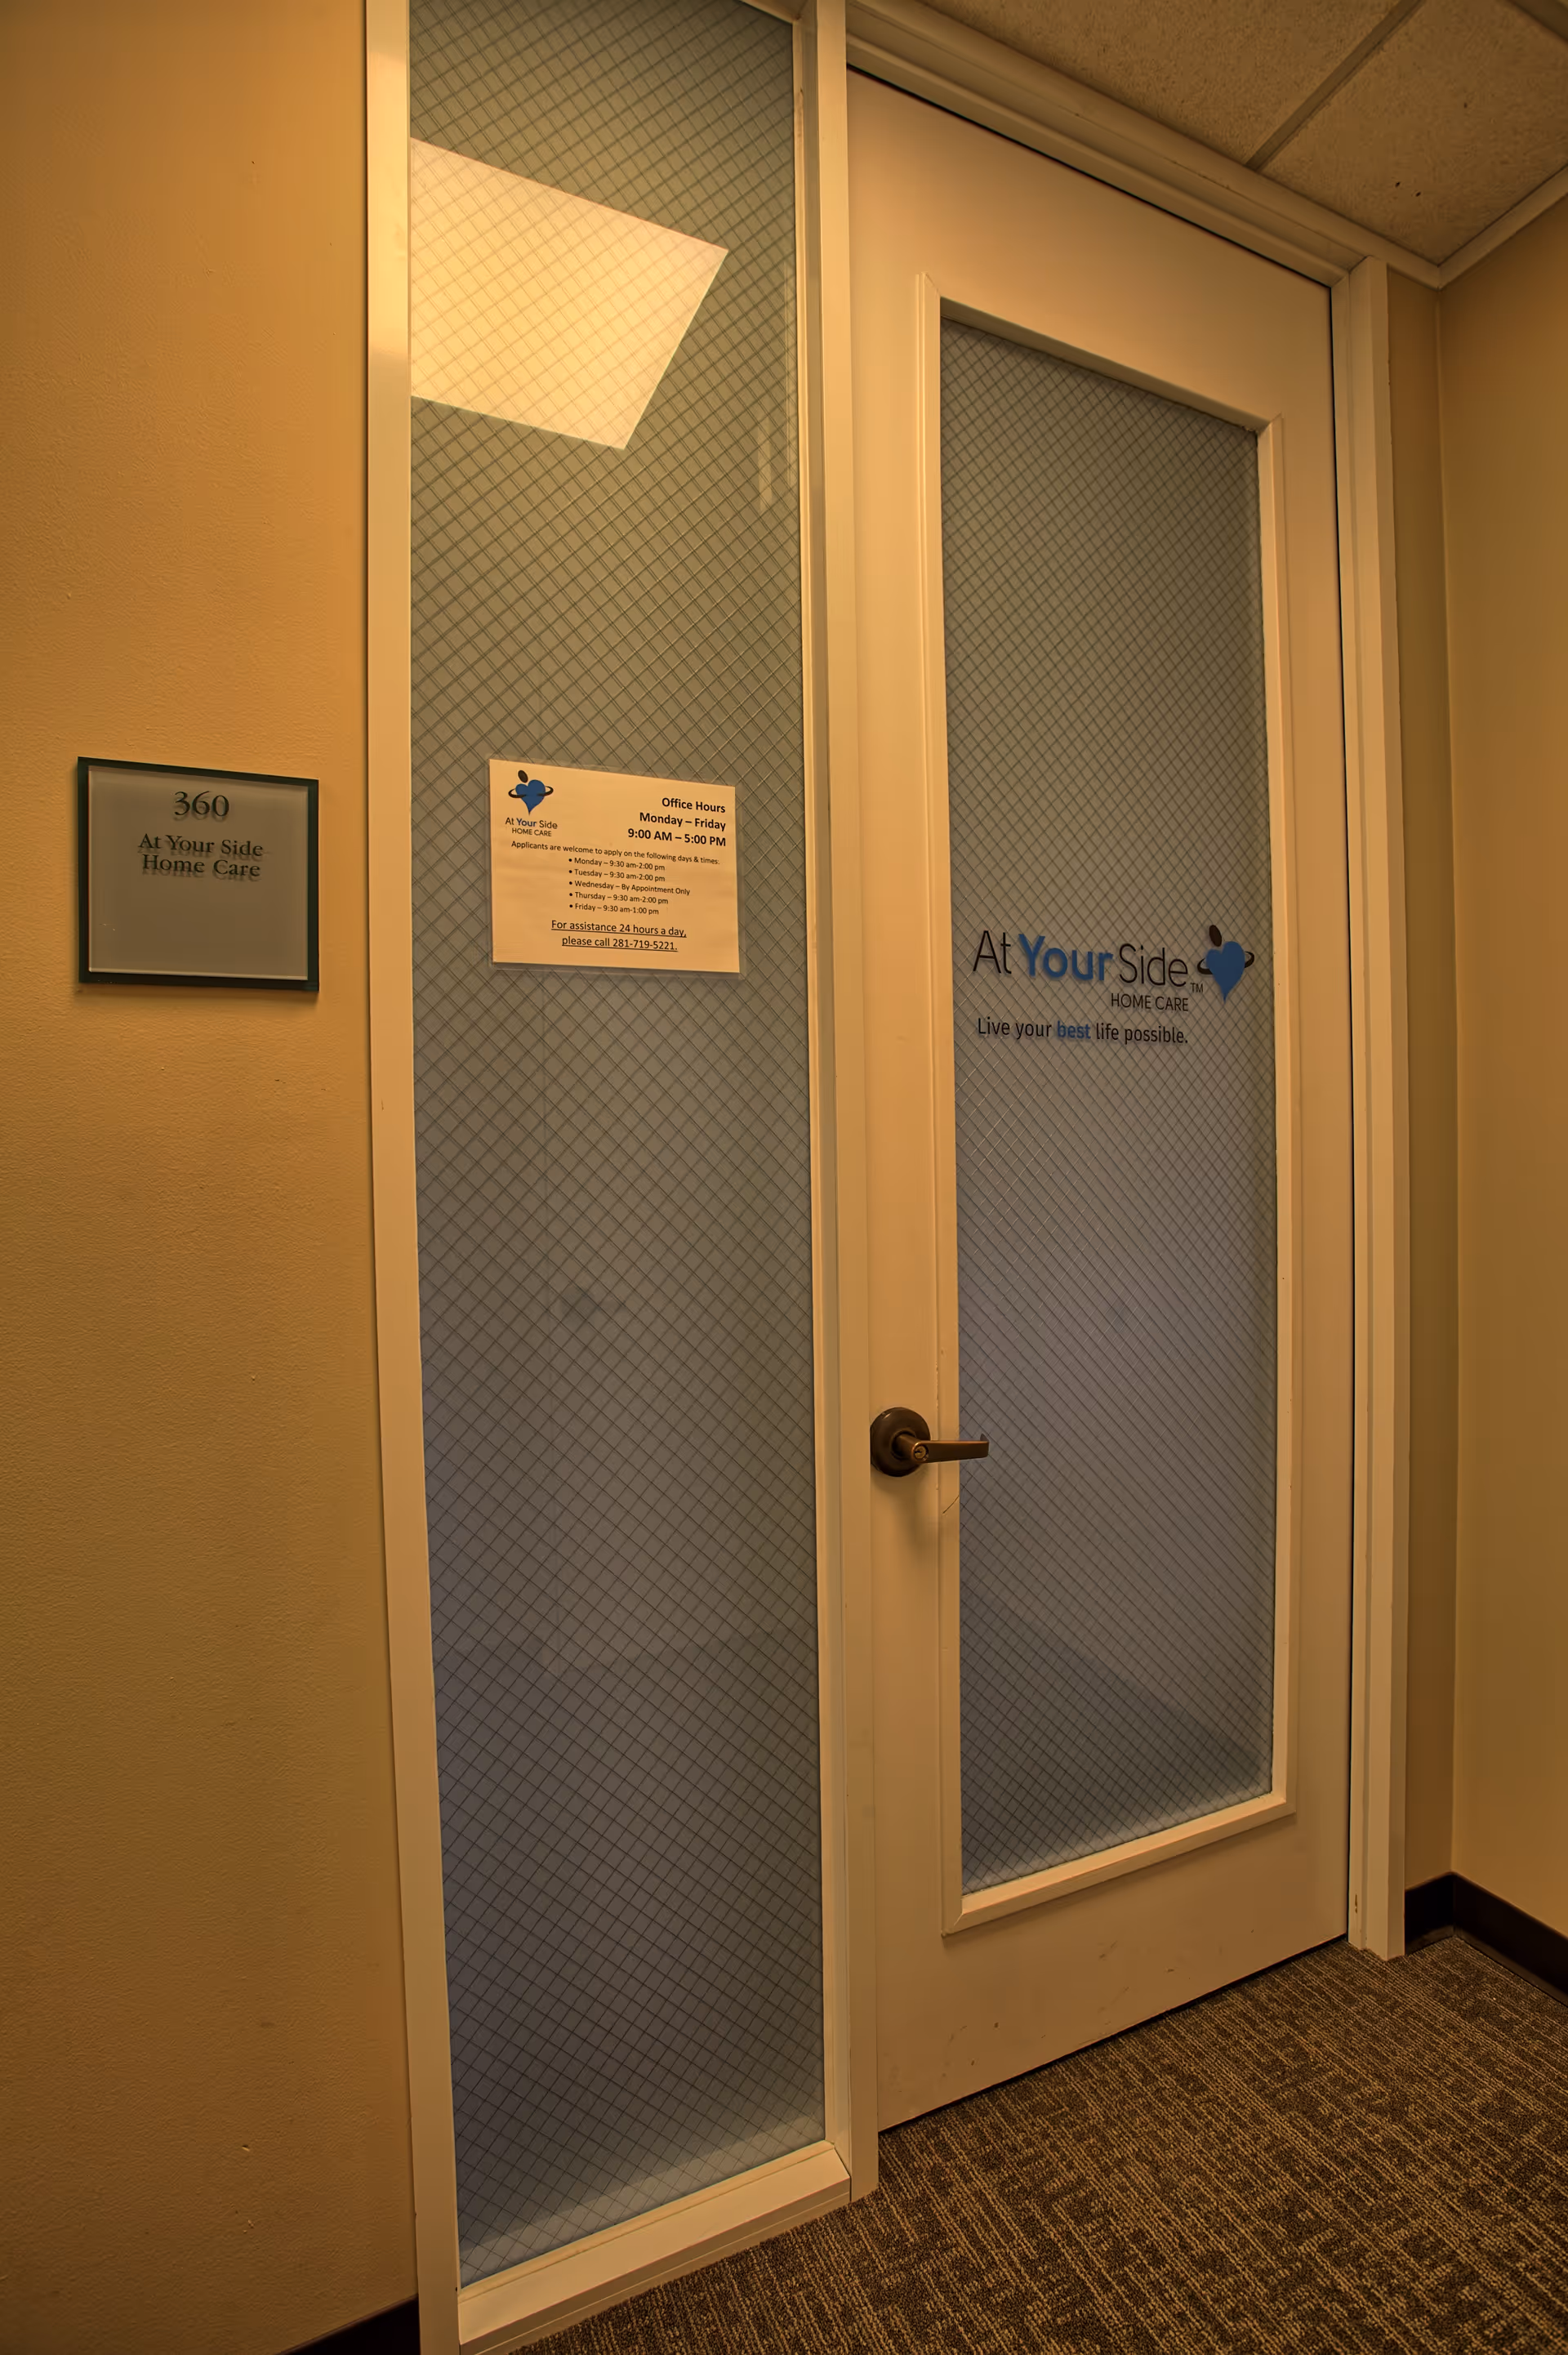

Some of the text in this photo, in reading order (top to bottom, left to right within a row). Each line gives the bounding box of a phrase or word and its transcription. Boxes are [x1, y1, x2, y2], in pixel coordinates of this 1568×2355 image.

[174, 791, 229, 817] 360
[662, 797, 726, 813] Office Hours
[506, 817, 558, 829] At Your Side
[639, 812, 683, 827] Monday
[695, 818, 726, 832] Friday
[138, 833, 263, 856] At Your Side
[628, 828, 651, 839] 9:00
[654, 831, 672, 841] AM
[684, 834, 706, 845] 5:00
[710, 836, 726, 846] PM
[511, 841, 548, 850] Applicants
[564, 845, 594, 854] welcome
[646, 852, 675, 862] following
[678, 855, 693, 863] days
[142, 854, 261, 876] Home Care
[574, 858, 603, 867] Monday
[626, 862, 653, 871] am-2:00
[574, 869, 603, 878] Tuesday
[626, 873, 653, 881] am-2:00
[575, 881, 614, 890] Wednesday
[631, 885, 674, 894] Appointment
[675, 888, 690, 896] Only
[575, 892, 606, 901] Thursday
[575, 903, 596, 912] Friday
[551, 920, 567, 929] For
[570, 921, 617, 932] assistance
[619, 924, 630, 933] 24
[633, 925, 658, 934] hours
[668, 927, 687, 938] day,
[562, 937, 678, 951] please call 281-719-5221.
[973, 930, 1204, 993] At Your Side TM
[1111, 993, 1189, 1011] HOME CARE
[978, 1017, 1188, 1045] Live your best life possible.
